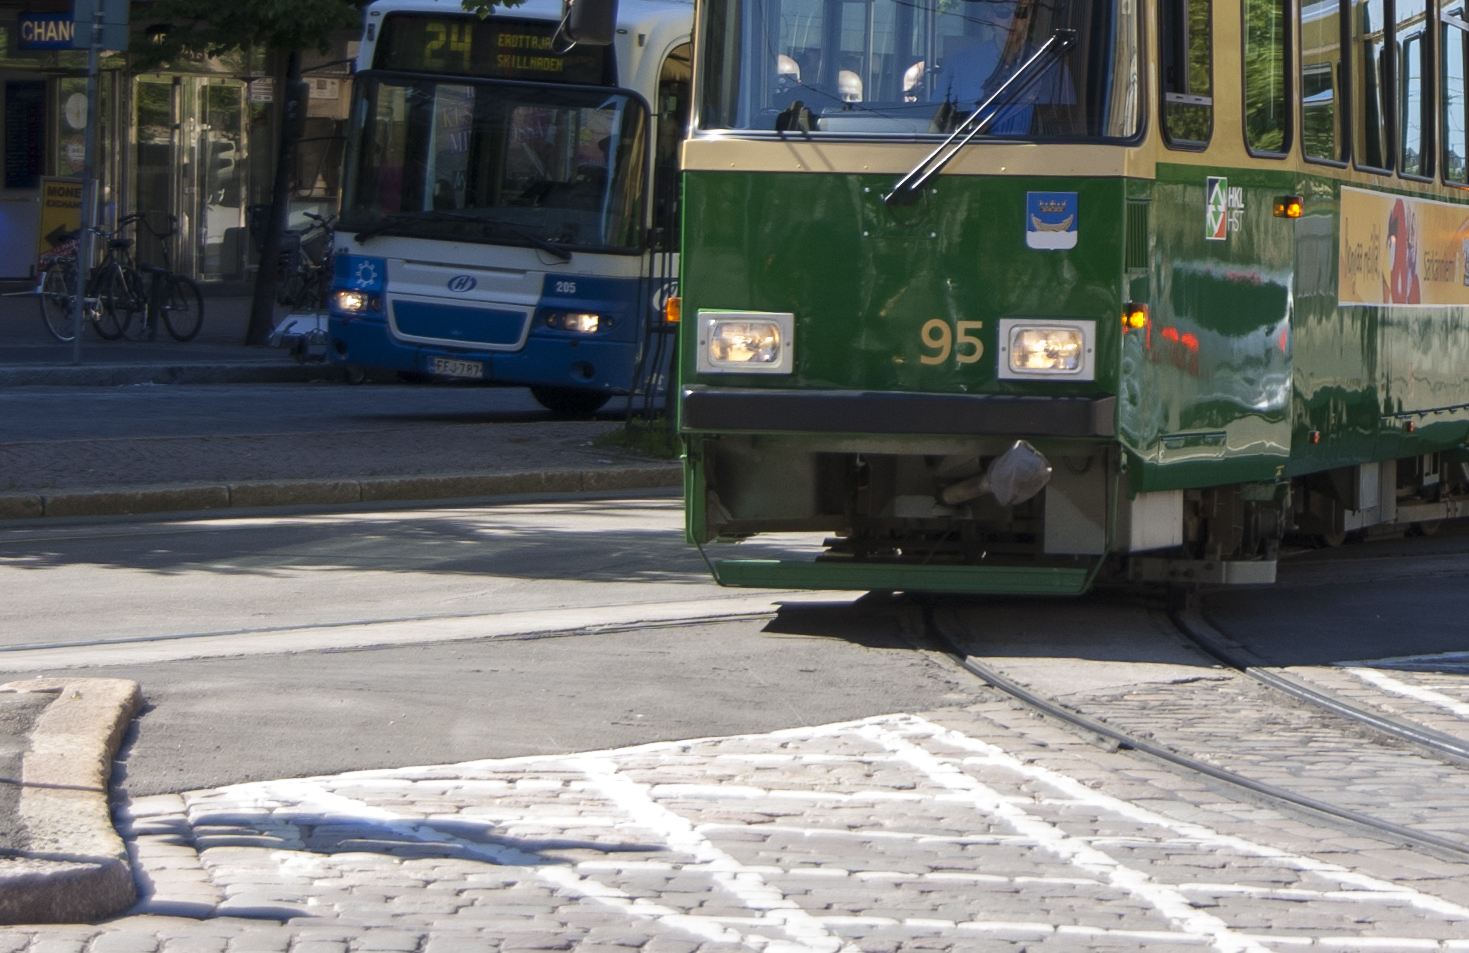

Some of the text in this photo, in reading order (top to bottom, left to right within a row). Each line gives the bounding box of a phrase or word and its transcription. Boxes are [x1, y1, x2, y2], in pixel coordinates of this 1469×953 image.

[22, 20, 75, 42] CHAN
[424, 21, 473, 70] 24
[46, 186, 83, 199] MONE
[1228, 186, 1245, 208] HKL
[1227, 210, 1245, 233] HST
[556, 281, 577, 294] 205
[920, 317, 984, 366] 95
